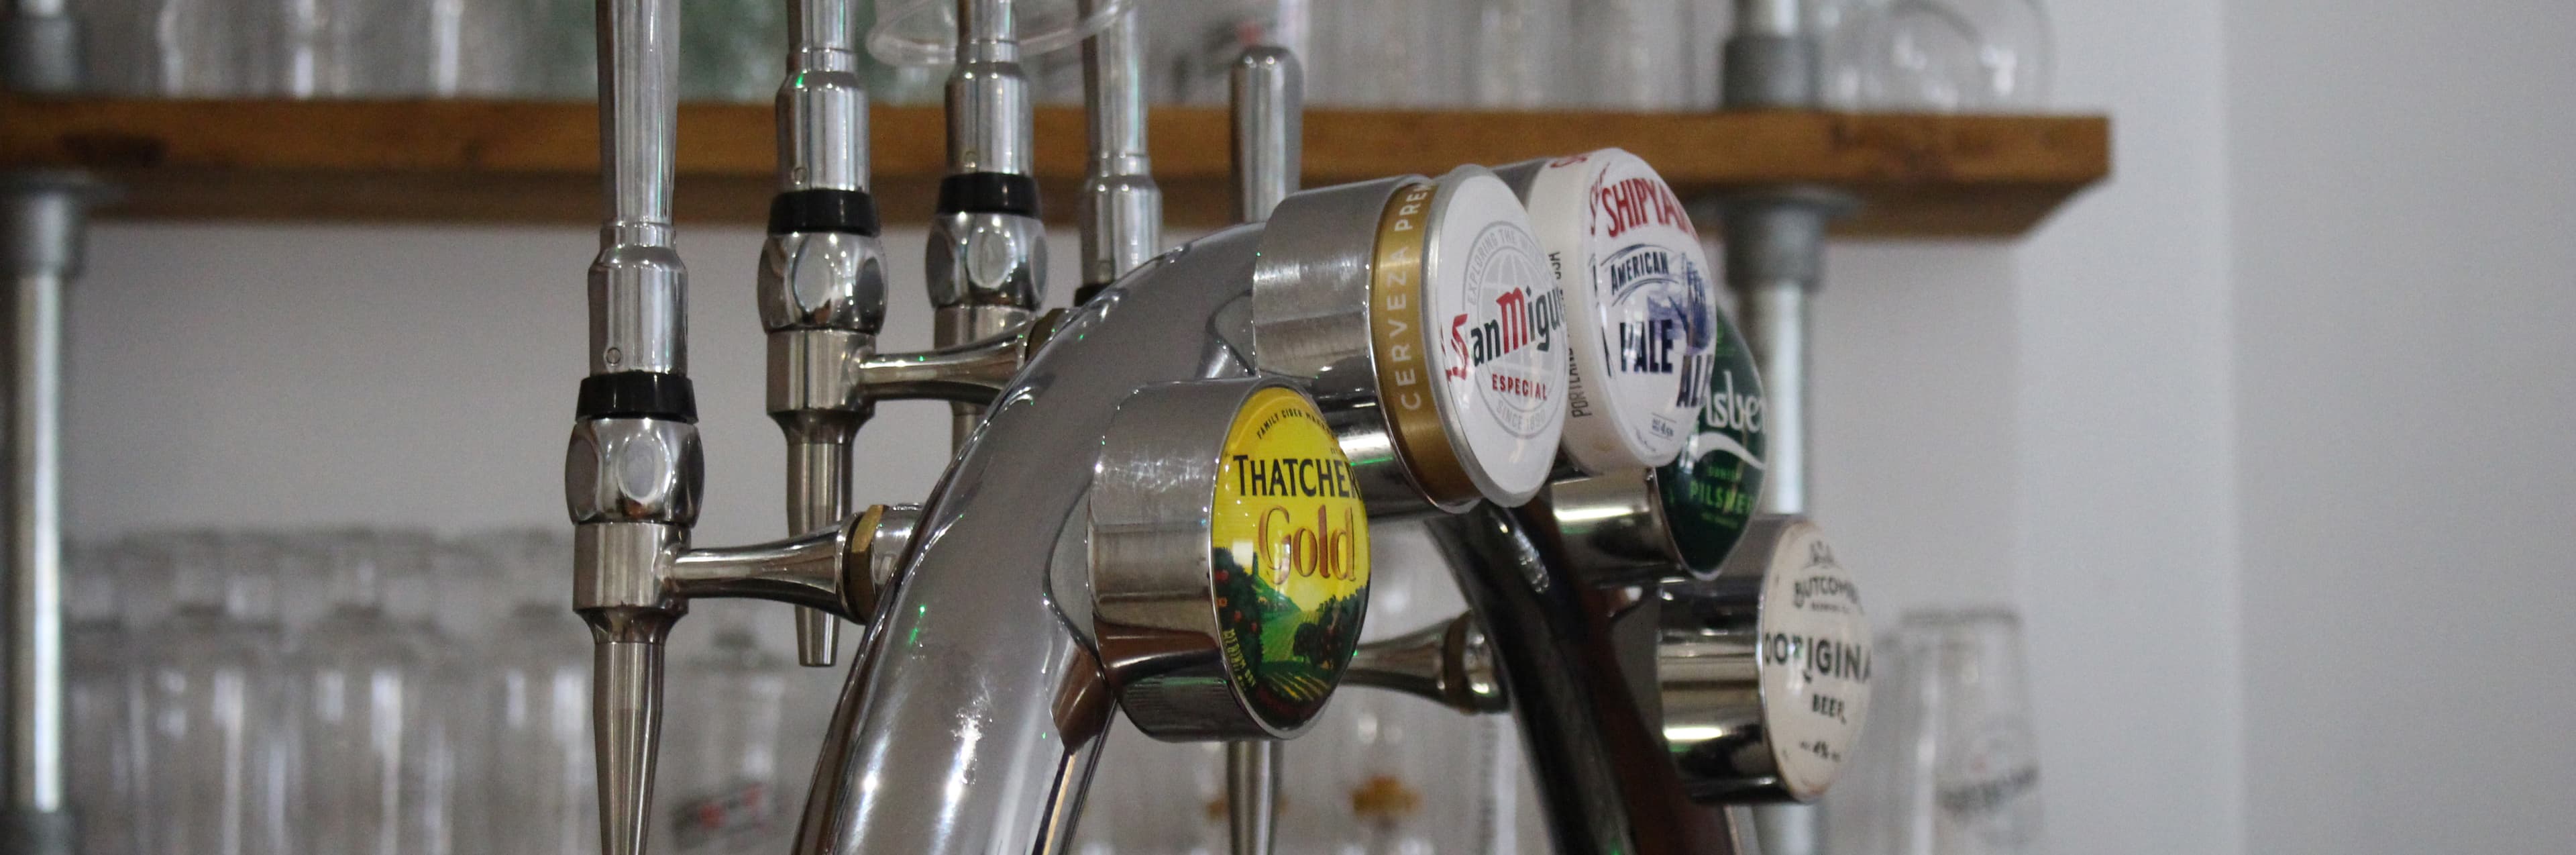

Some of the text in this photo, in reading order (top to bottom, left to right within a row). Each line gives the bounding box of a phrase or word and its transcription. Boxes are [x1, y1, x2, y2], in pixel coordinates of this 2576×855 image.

[1468, 232, 1499, 305] EXPLORING
[1611, 252, 1669, 295] AMERICAN
[1387, 246, 1421, 411] CERVEZA
[1620, 319, 1674, 373] PALE
[1492, 374, 1547, 401] ESPECIAL
[1569, 348, 1592, 418] PORTLA
[1676, 354, 1713, 408] ALE
[1256, 413, 1279, 440] FAMILY
[1497, 399, 1522, 430] SINCE
[1258, 504, 1356, 585] Gold
[1812, 693, 1847, 725] BEER
